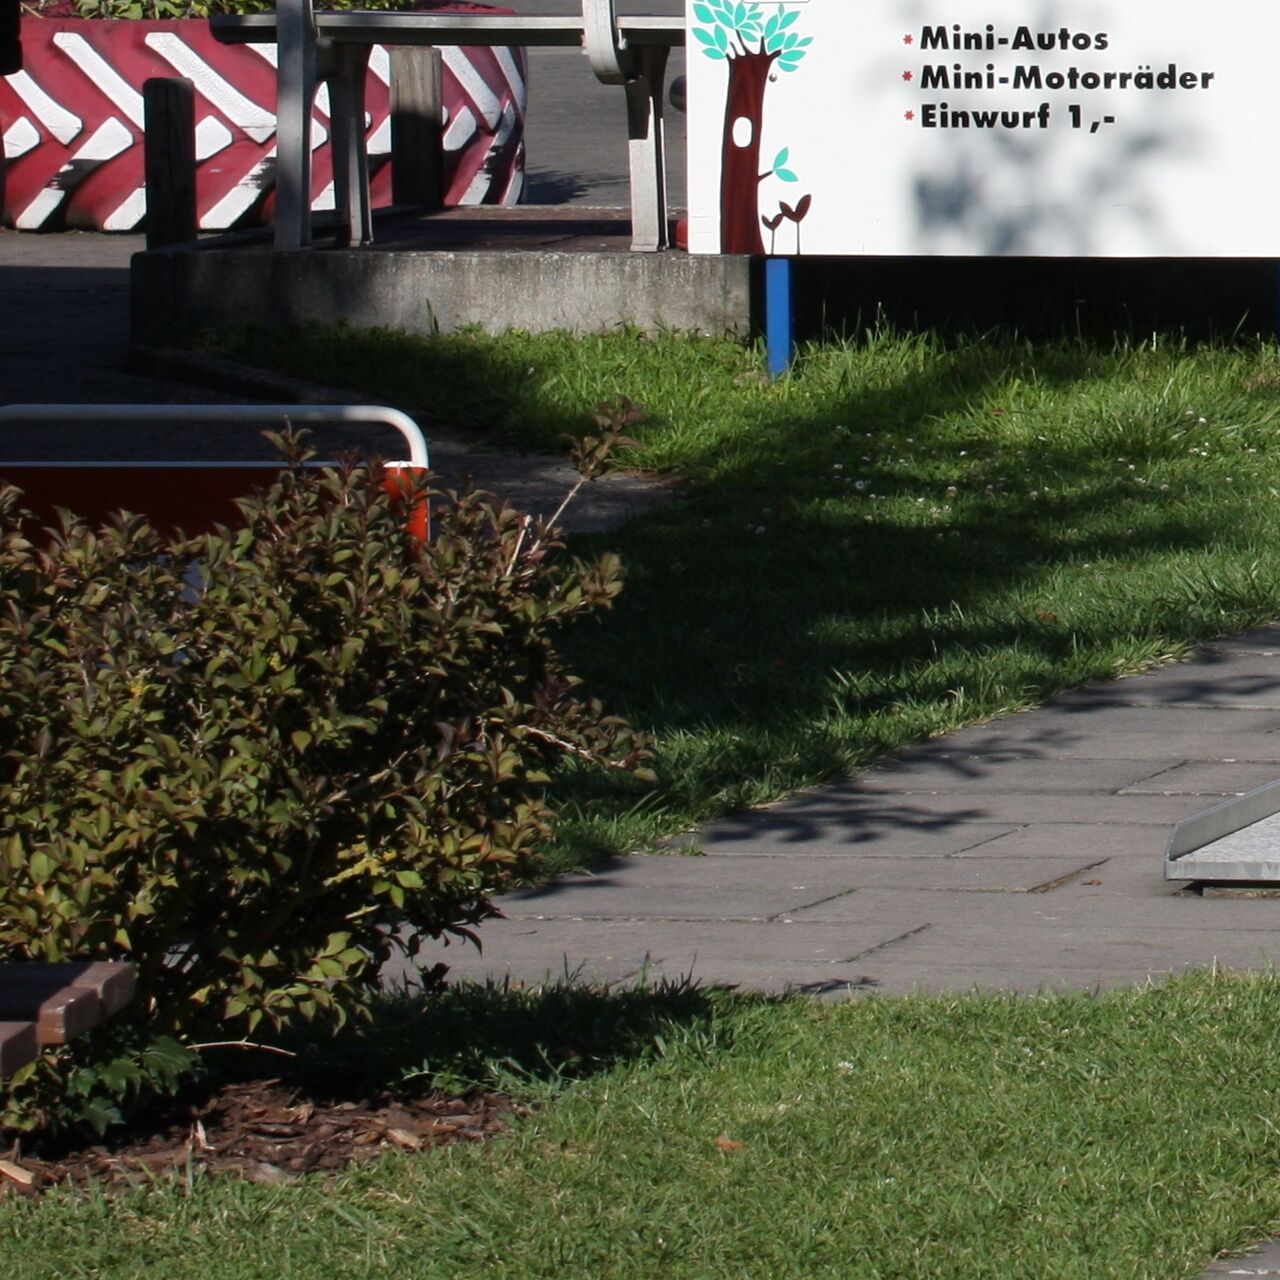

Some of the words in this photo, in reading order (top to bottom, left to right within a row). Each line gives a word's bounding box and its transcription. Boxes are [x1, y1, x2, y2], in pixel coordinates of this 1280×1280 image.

[920, 24, 1109, 51] Mini-Autos
[920, 63, 1215, 90] Mini-Motorräder
[921, 103, 1050, 129] Einwurf
